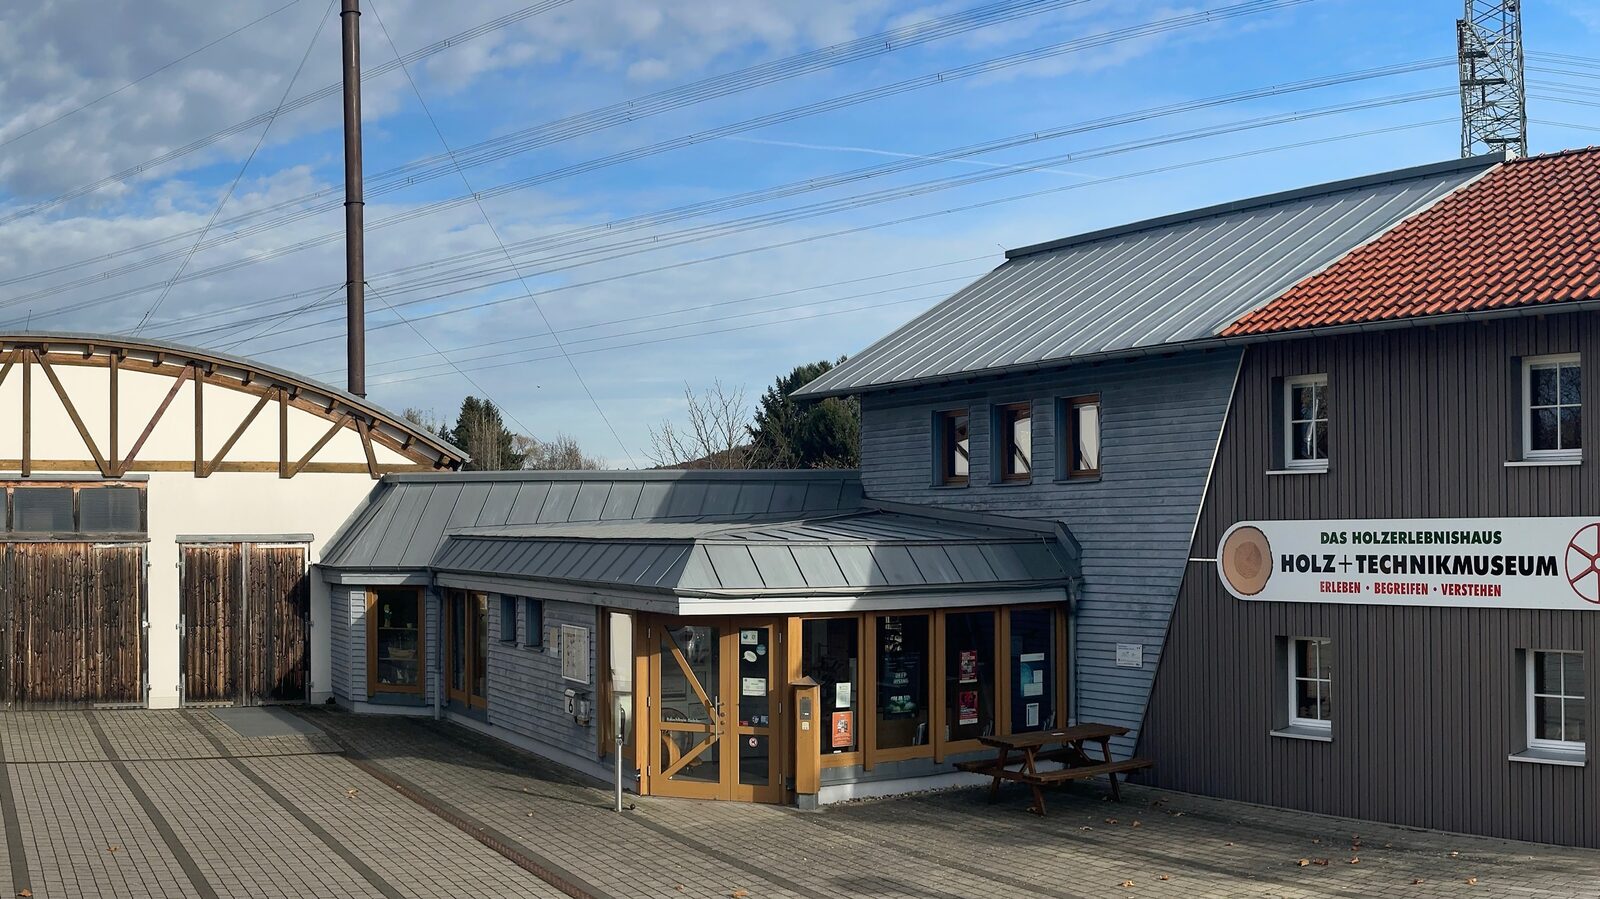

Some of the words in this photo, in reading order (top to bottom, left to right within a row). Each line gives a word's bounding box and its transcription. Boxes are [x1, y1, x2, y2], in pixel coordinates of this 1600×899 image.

[1320, 531, 1347, 545] DAS
[1352, 531, 1502, 545] HOLZERLEBNISHAUS
[1320, 581, 1361, 593] ERLEBEN
[1374, 582, 1429, 595] BEGREIFEN
[1441, 583, 1502, 597] VERSTEHEN
[568, 698, 574, 713] 6
